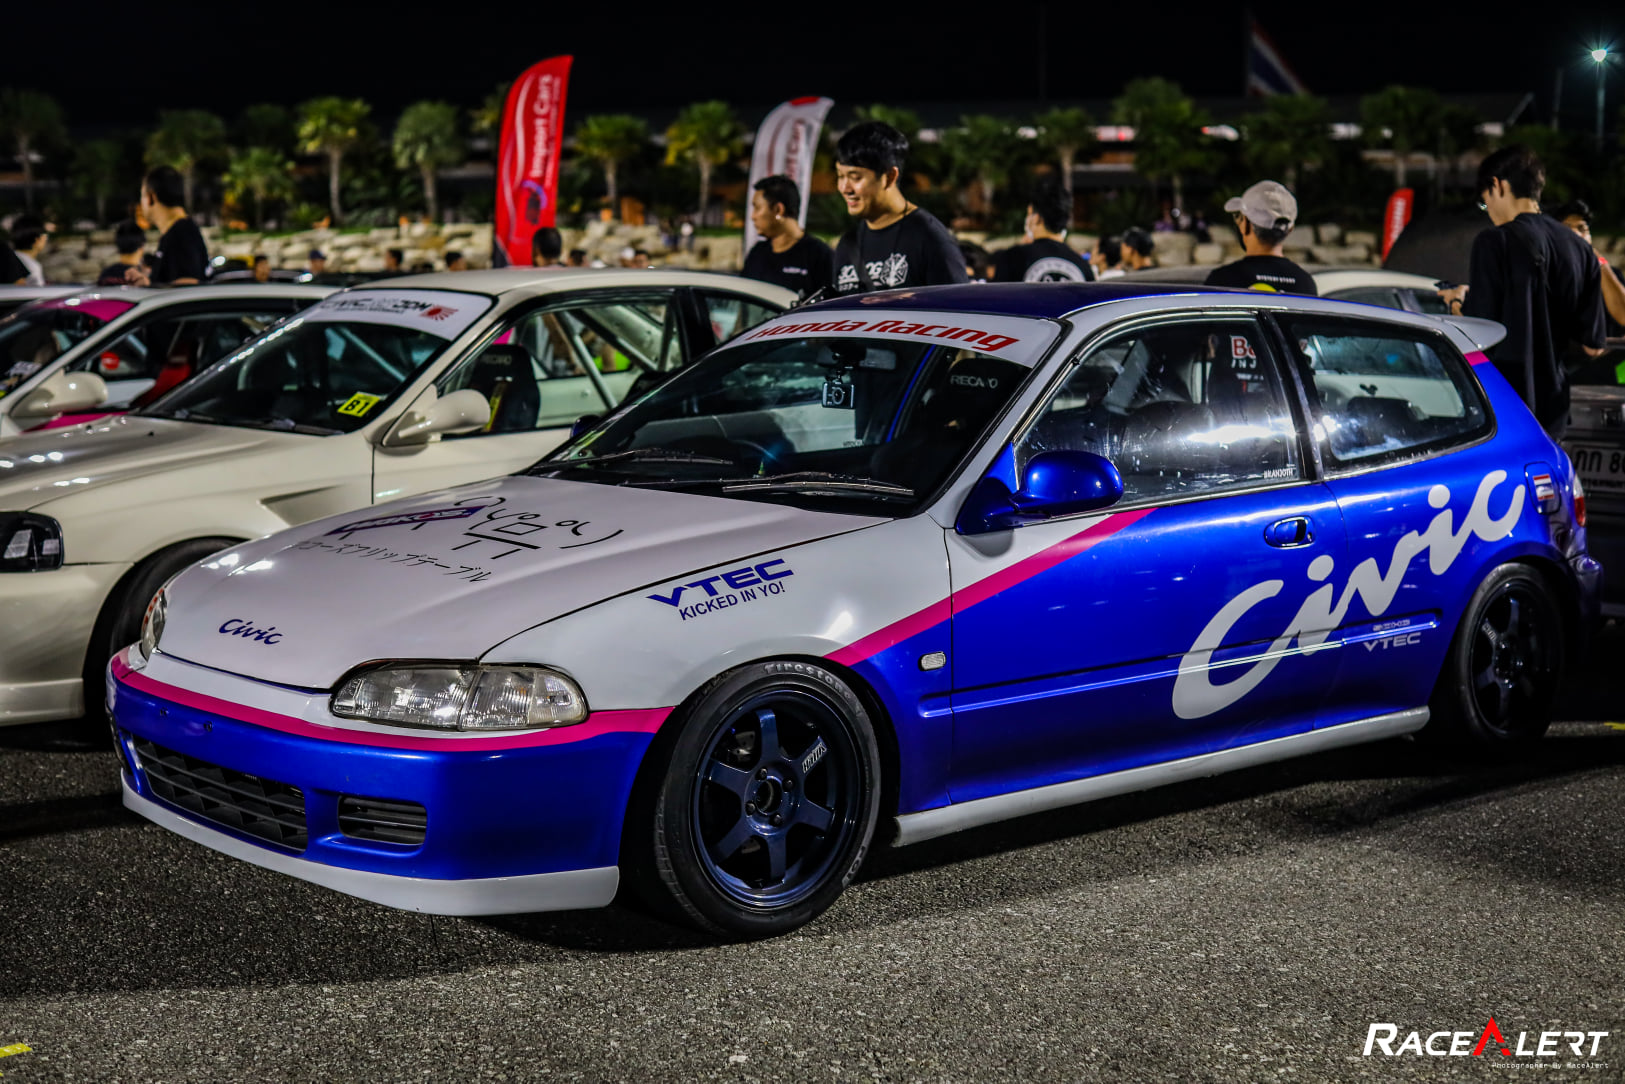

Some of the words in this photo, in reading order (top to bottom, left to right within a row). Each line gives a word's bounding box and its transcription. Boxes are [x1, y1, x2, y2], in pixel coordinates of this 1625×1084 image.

[746, 319, 868, 341] Honda
[864, 319, 1019, 352] Racing
[950, 374, 999, 389] RECAO
[646, 558, 795, 608] VTEC
[1171, 469, 1526, 720] Civic
[678, 593, 739, 621] KICKED
[740, 588, 758, 603] IN
[757, 580, 786, 598] YO!
[218, 618, 283, 645] Civic
[1362, 631, 1422, 653] VTEC
